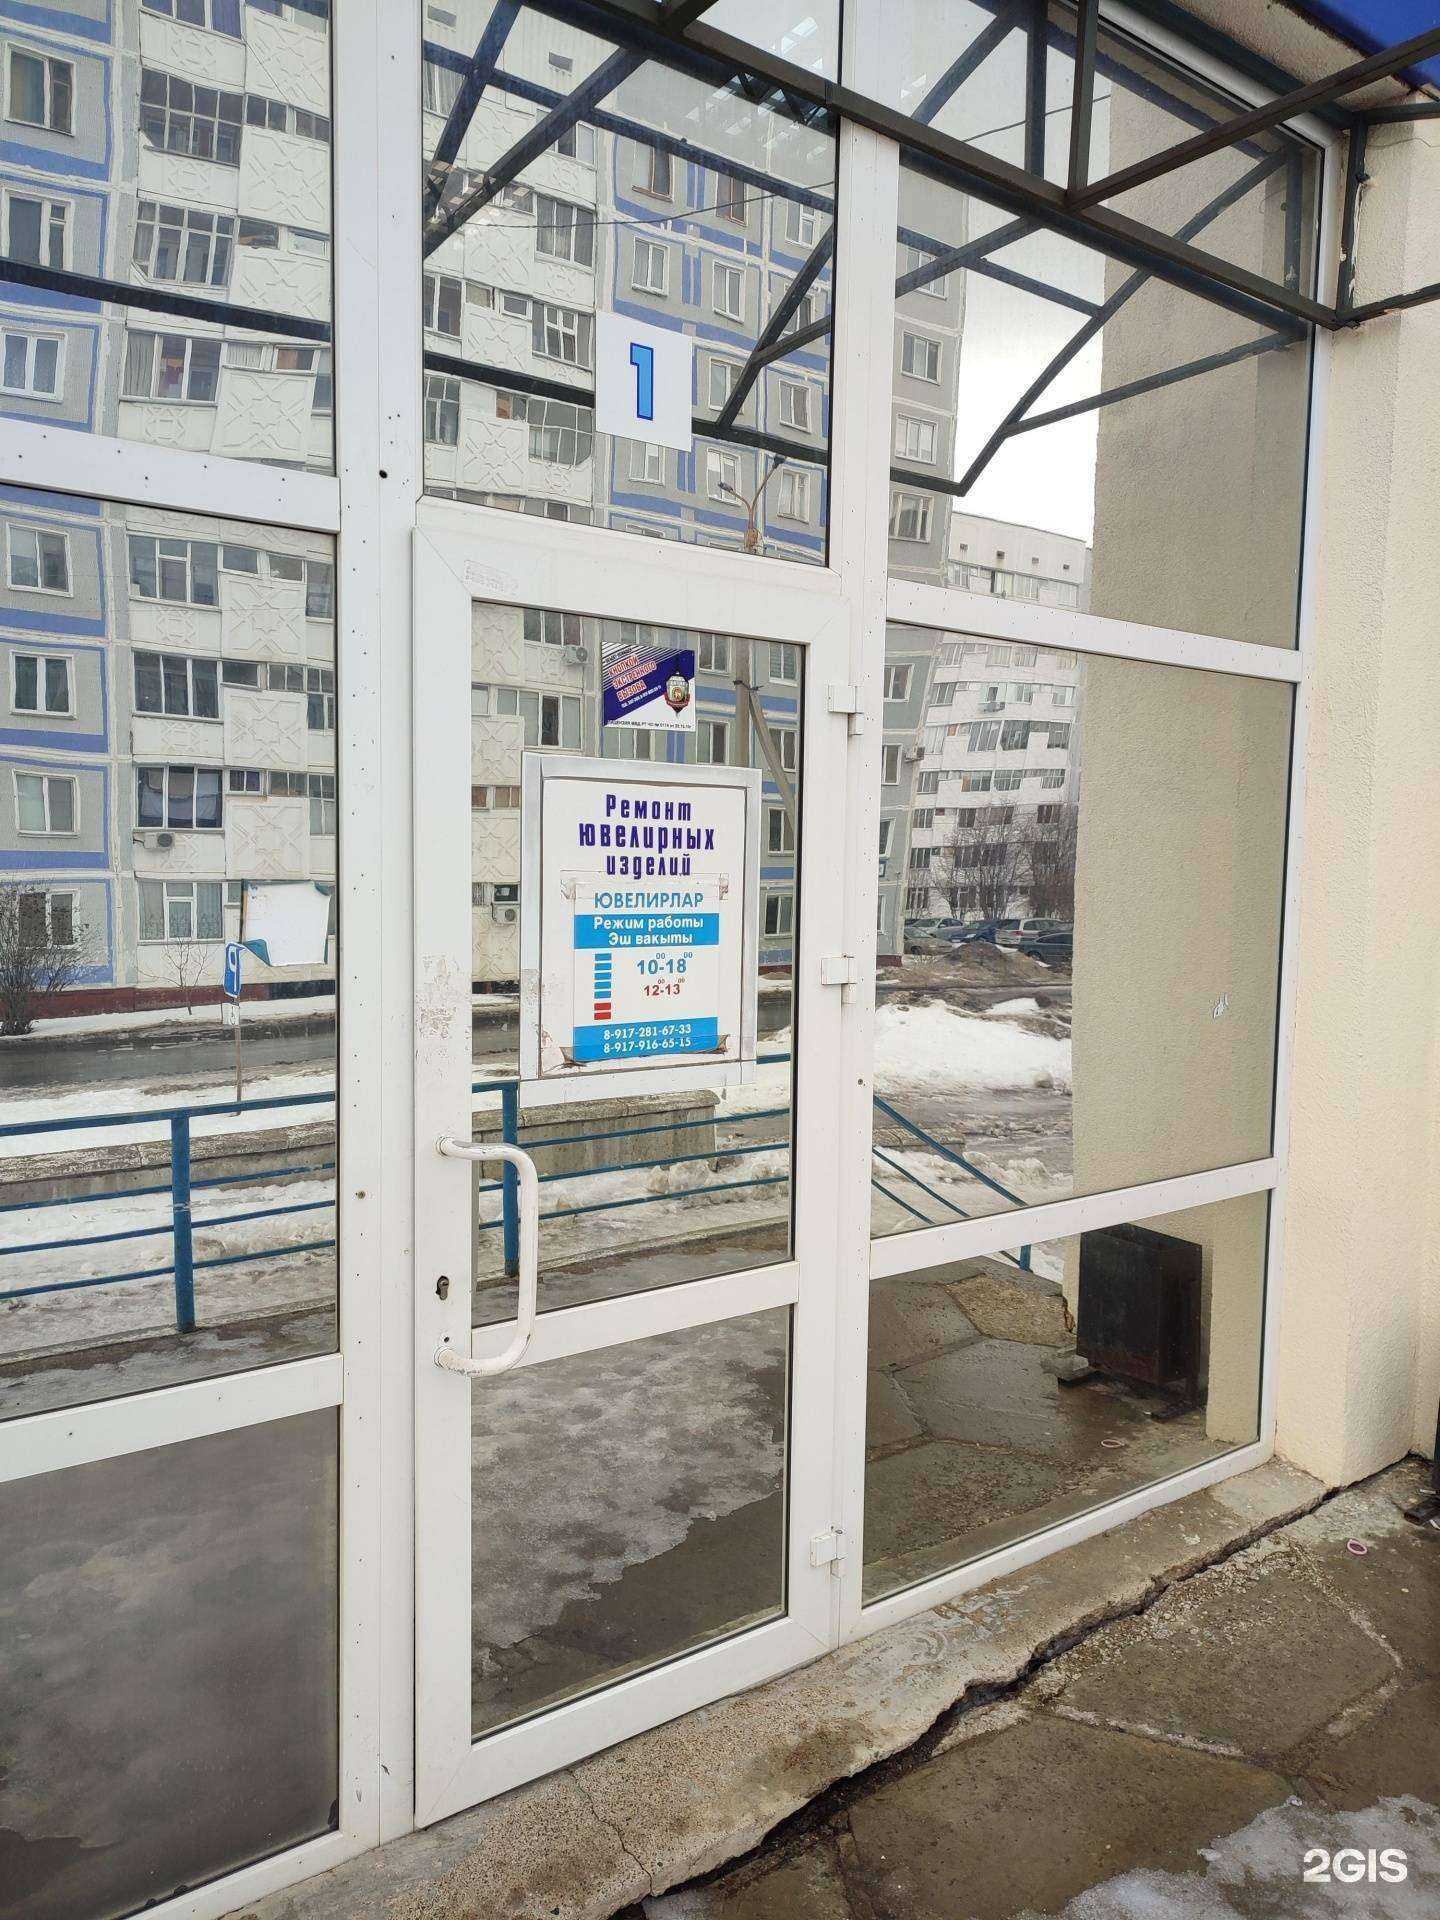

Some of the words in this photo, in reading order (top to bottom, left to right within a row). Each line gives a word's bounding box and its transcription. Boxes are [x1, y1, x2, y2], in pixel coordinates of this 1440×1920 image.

[630, 342, 653, 421] 1
[612, 660, 657, 689] ЭКСТРЕННОГО
[617, 680, 647, 701] ВЫЗОВА
[606, 794, 691, 821] Ремонт
[606, 853, 691, 880] изделий
[595, 892, 704, 909] ЮВЕЛИРЛАР
[594, 916, 644, 930] Режим
[648, 916, 704, 932] работы
[608, 932, 632, 946] Эш
[635, 932, 693, 945] вакыты
[603, 1023, 692, 1041] 8-917-281-67-33
[603, 1037, 692, 1054] 8-917-916-65-15
